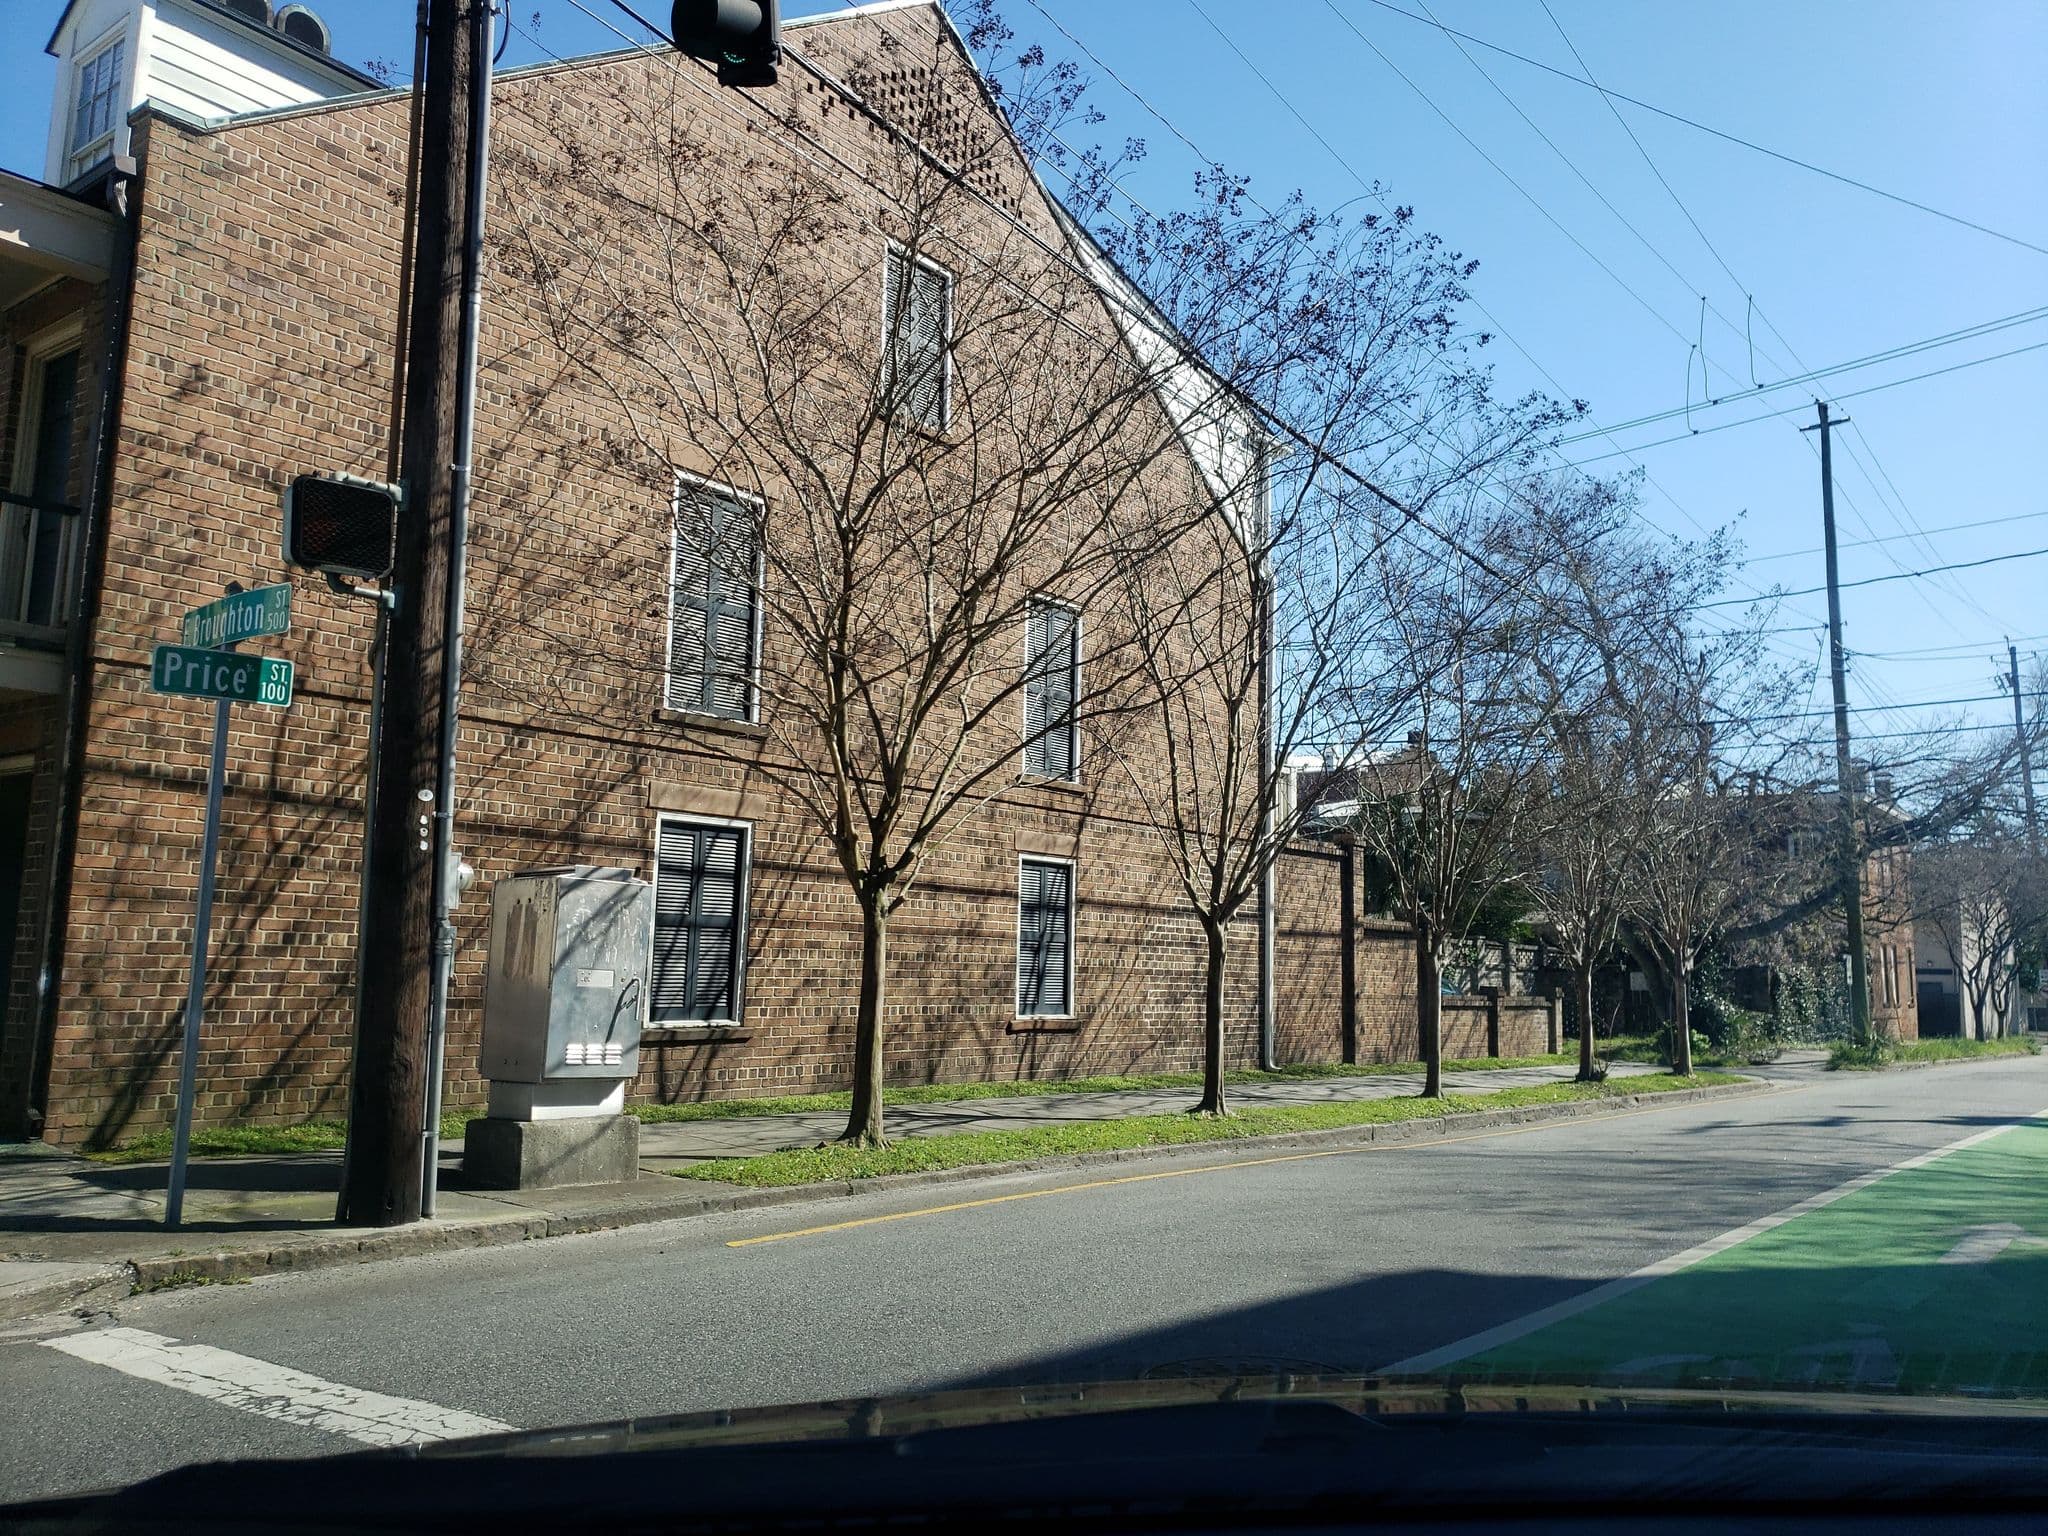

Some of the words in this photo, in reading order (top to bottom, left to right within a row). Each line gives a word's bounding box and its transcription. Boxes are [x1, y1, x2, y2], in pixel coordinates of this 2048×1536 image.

[193, 601, 264, 646] Broughton
[266, 611, 286, 631] 500
[163, 652, 248, 694] Price
[261, 682, 286, 702] 100
